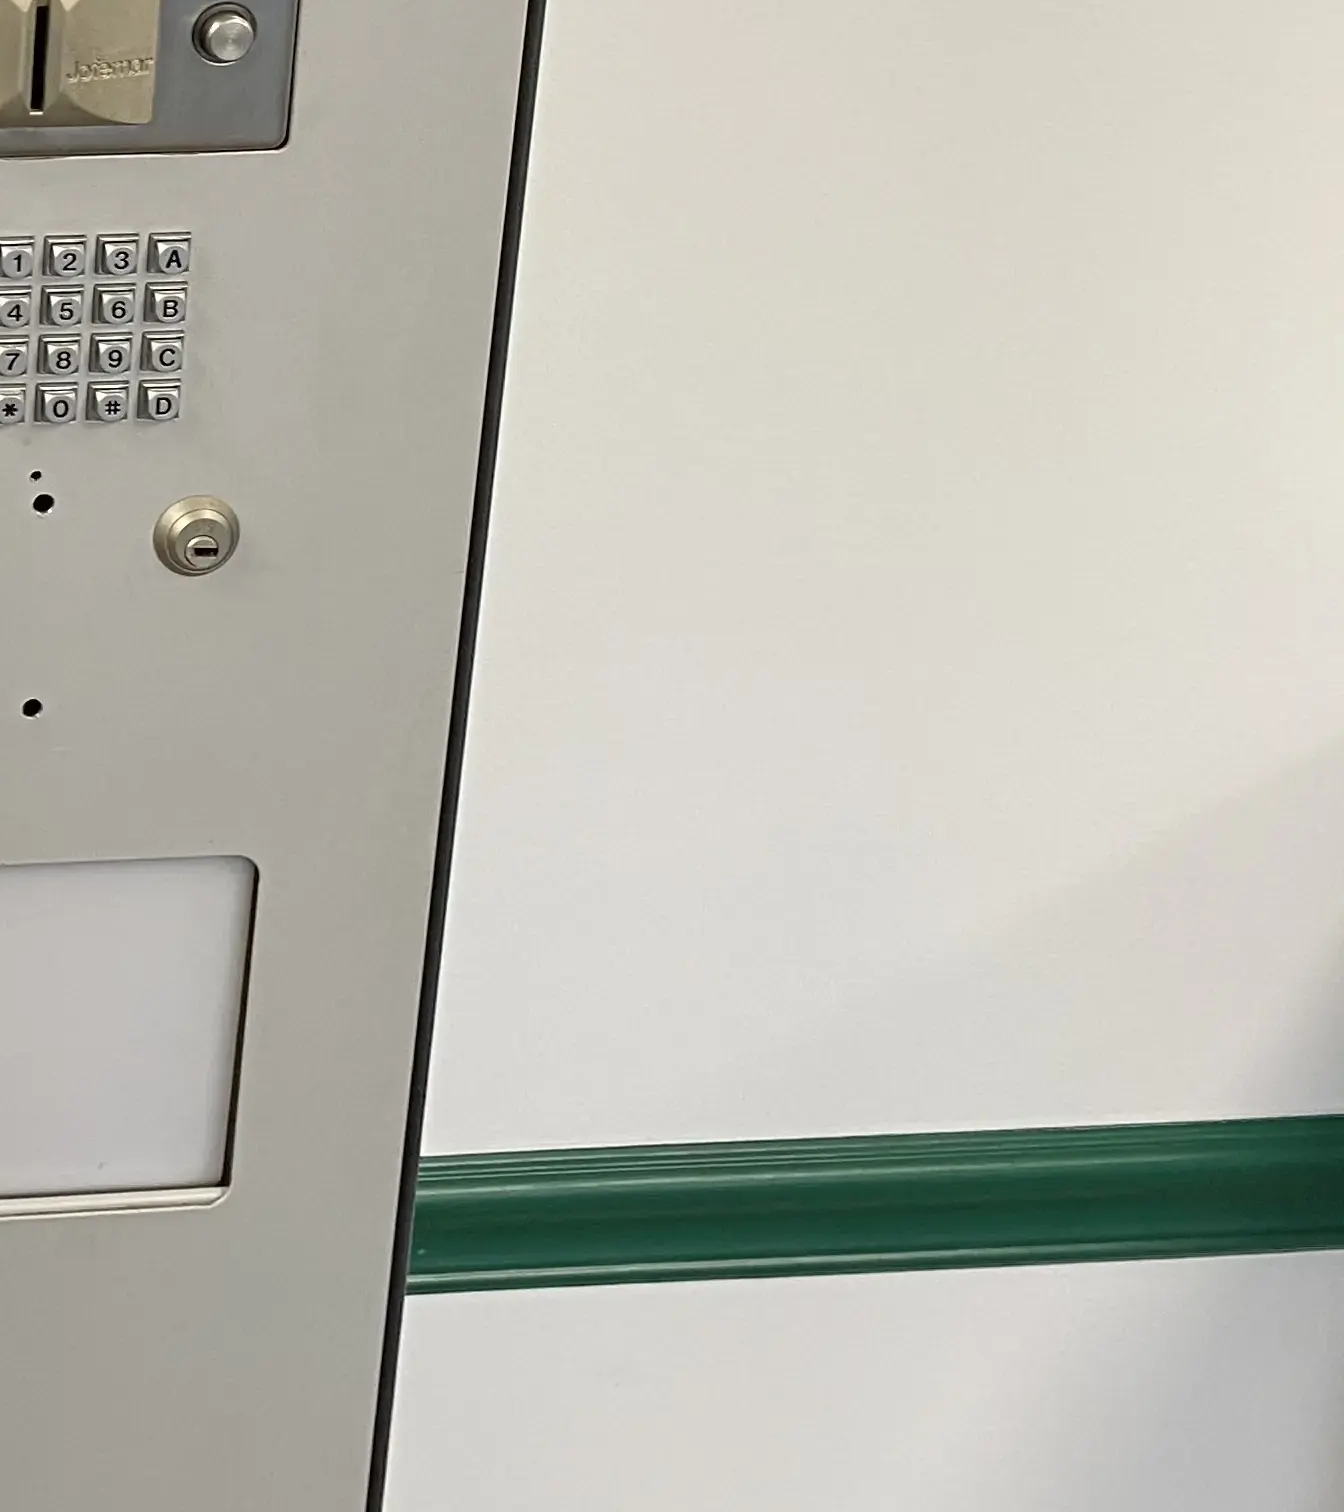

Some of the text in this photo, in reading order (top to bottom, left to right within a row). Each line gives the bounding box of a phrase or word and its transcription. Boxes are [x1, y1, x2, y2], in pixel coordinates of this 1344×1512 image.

[13, 249, 182, 272] 1 2 3 A
[7, 299, 179, 322] 4 5 6 B
[5, 348, 176, 370] 7 8 9 C
[53, 399, 69, 418] 0
[156, 397, 172, 415] D
